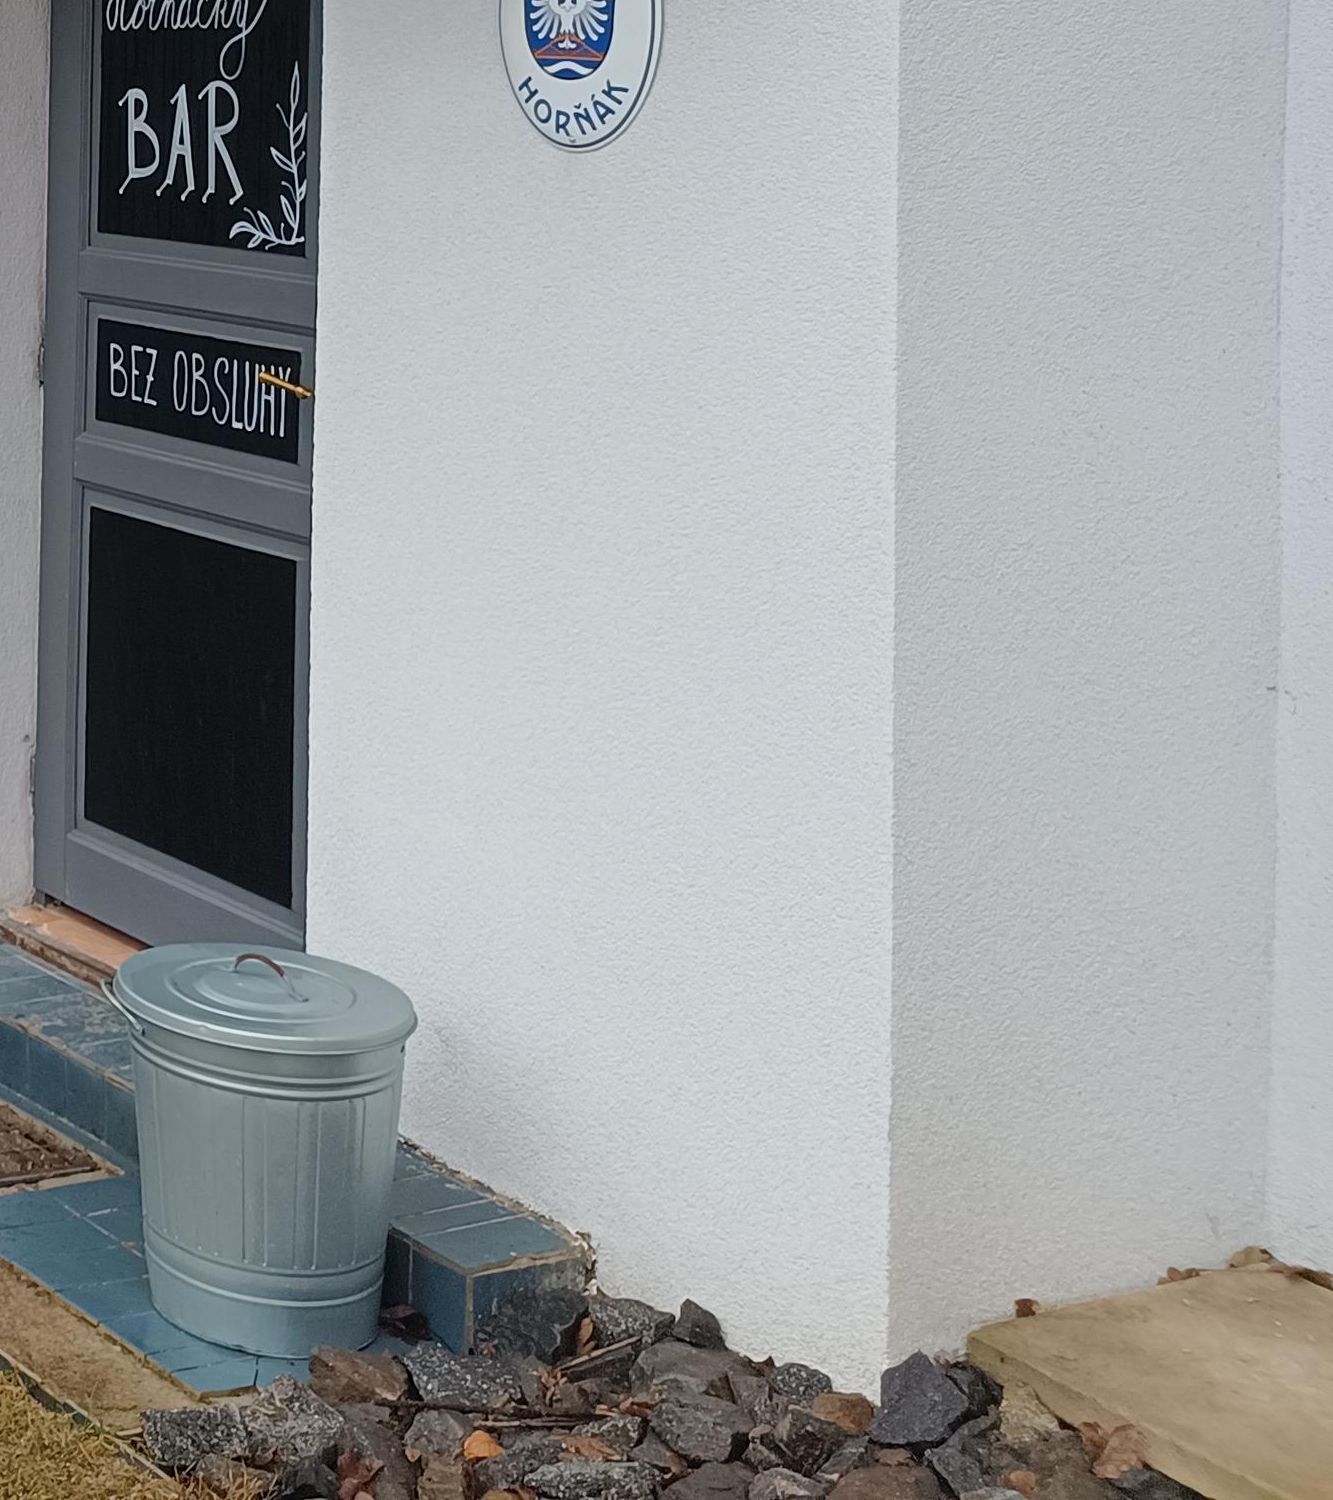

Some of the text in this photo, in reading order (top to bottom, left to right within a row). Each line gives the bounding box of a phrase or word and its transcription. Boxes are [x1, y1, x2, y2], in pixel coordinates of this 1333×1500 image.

[118, 80, 244, 205] BAR
[518, 76, 629, 137] HORŇÁK
[109, 342, 292, 438] BEZ OBSLUHY
